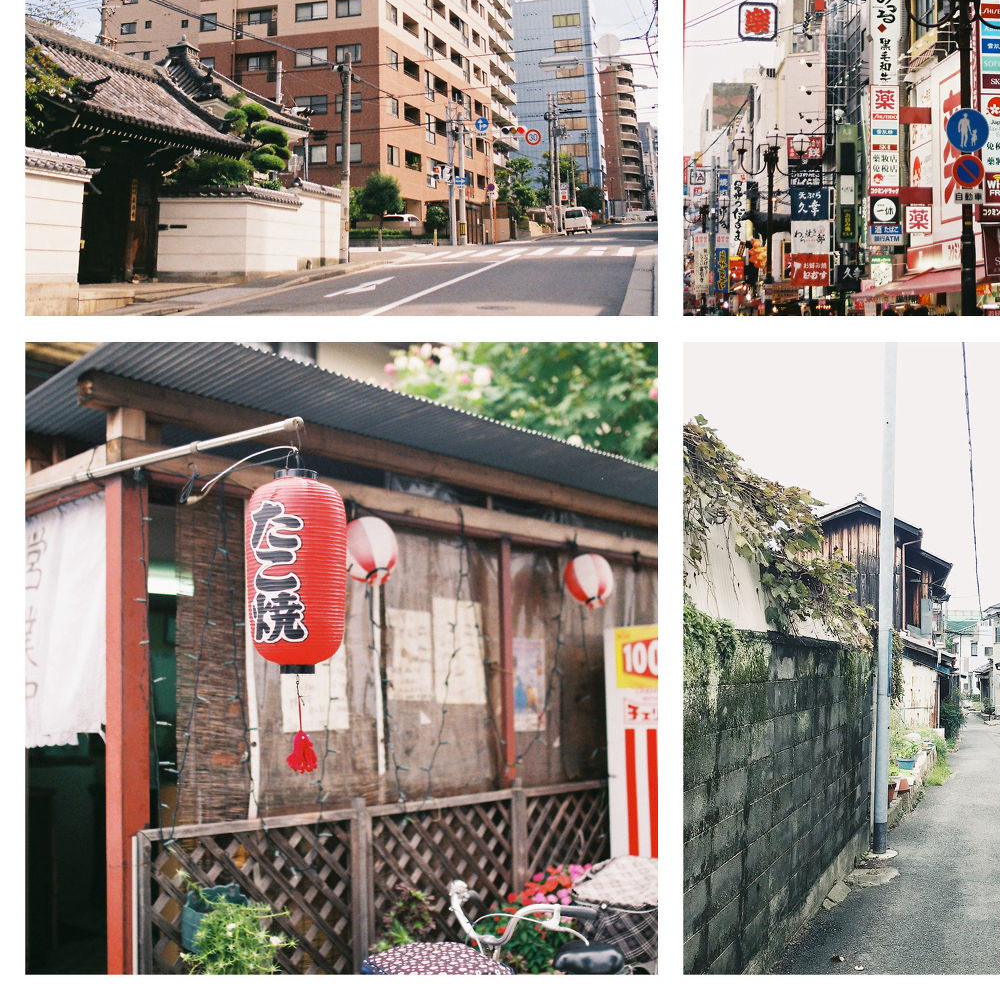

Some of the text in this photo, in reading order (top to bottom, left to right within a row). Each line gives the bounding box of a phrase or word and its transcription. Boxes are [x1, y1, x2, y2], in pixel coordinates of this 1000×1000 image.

[876, 90, 894, 109] 薬
[529, 134, 538, 142] 30
[798, 191, 821, 199] 天ぷら
[955, 192, 982, 201] 自動車
[798, 200, 820, 216] 久幸
[909, 209, 928, 229] 薬
[250, 500, 309, 643] たこ焼
